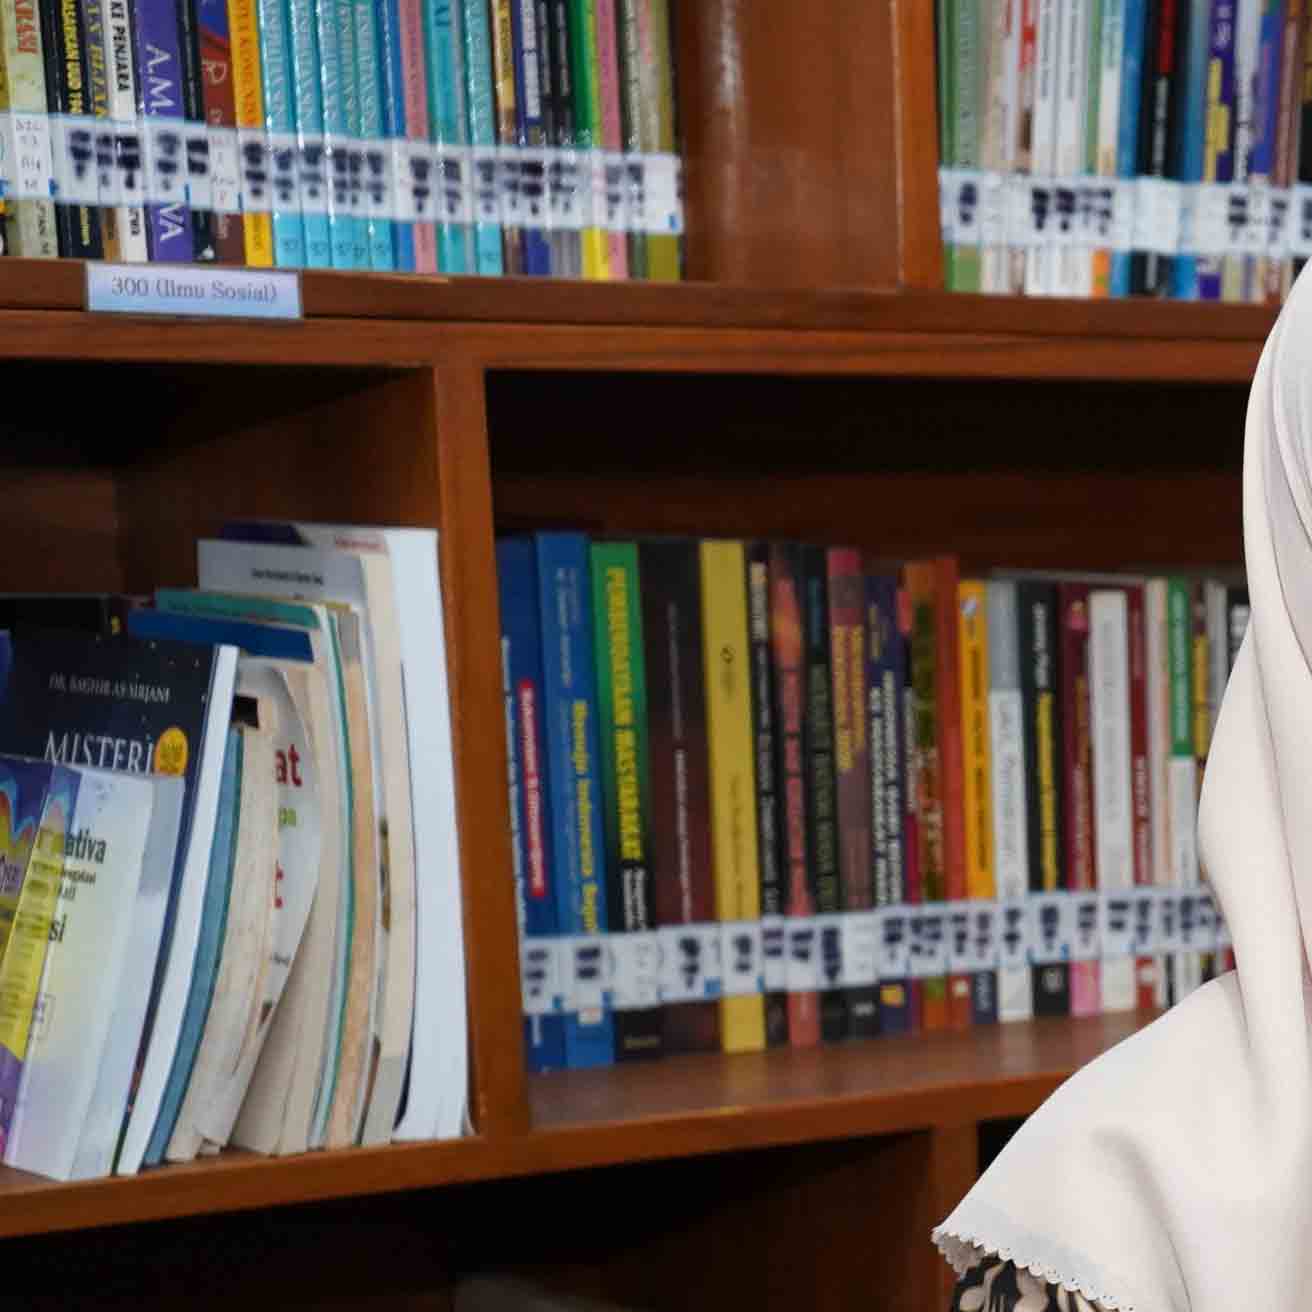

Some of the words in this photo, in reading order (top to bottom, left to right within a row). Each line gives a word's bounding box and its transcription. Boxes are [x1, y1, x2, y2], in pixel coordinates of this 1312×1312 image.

[112, 24, 131, 93] PENJARA
[111, 276, 149, 297] 300
[155, 277, 206, 300] (Ilmu
[211, 279, 278, 304] Sosial)
[43, 730, 155, 777] MISTERI
